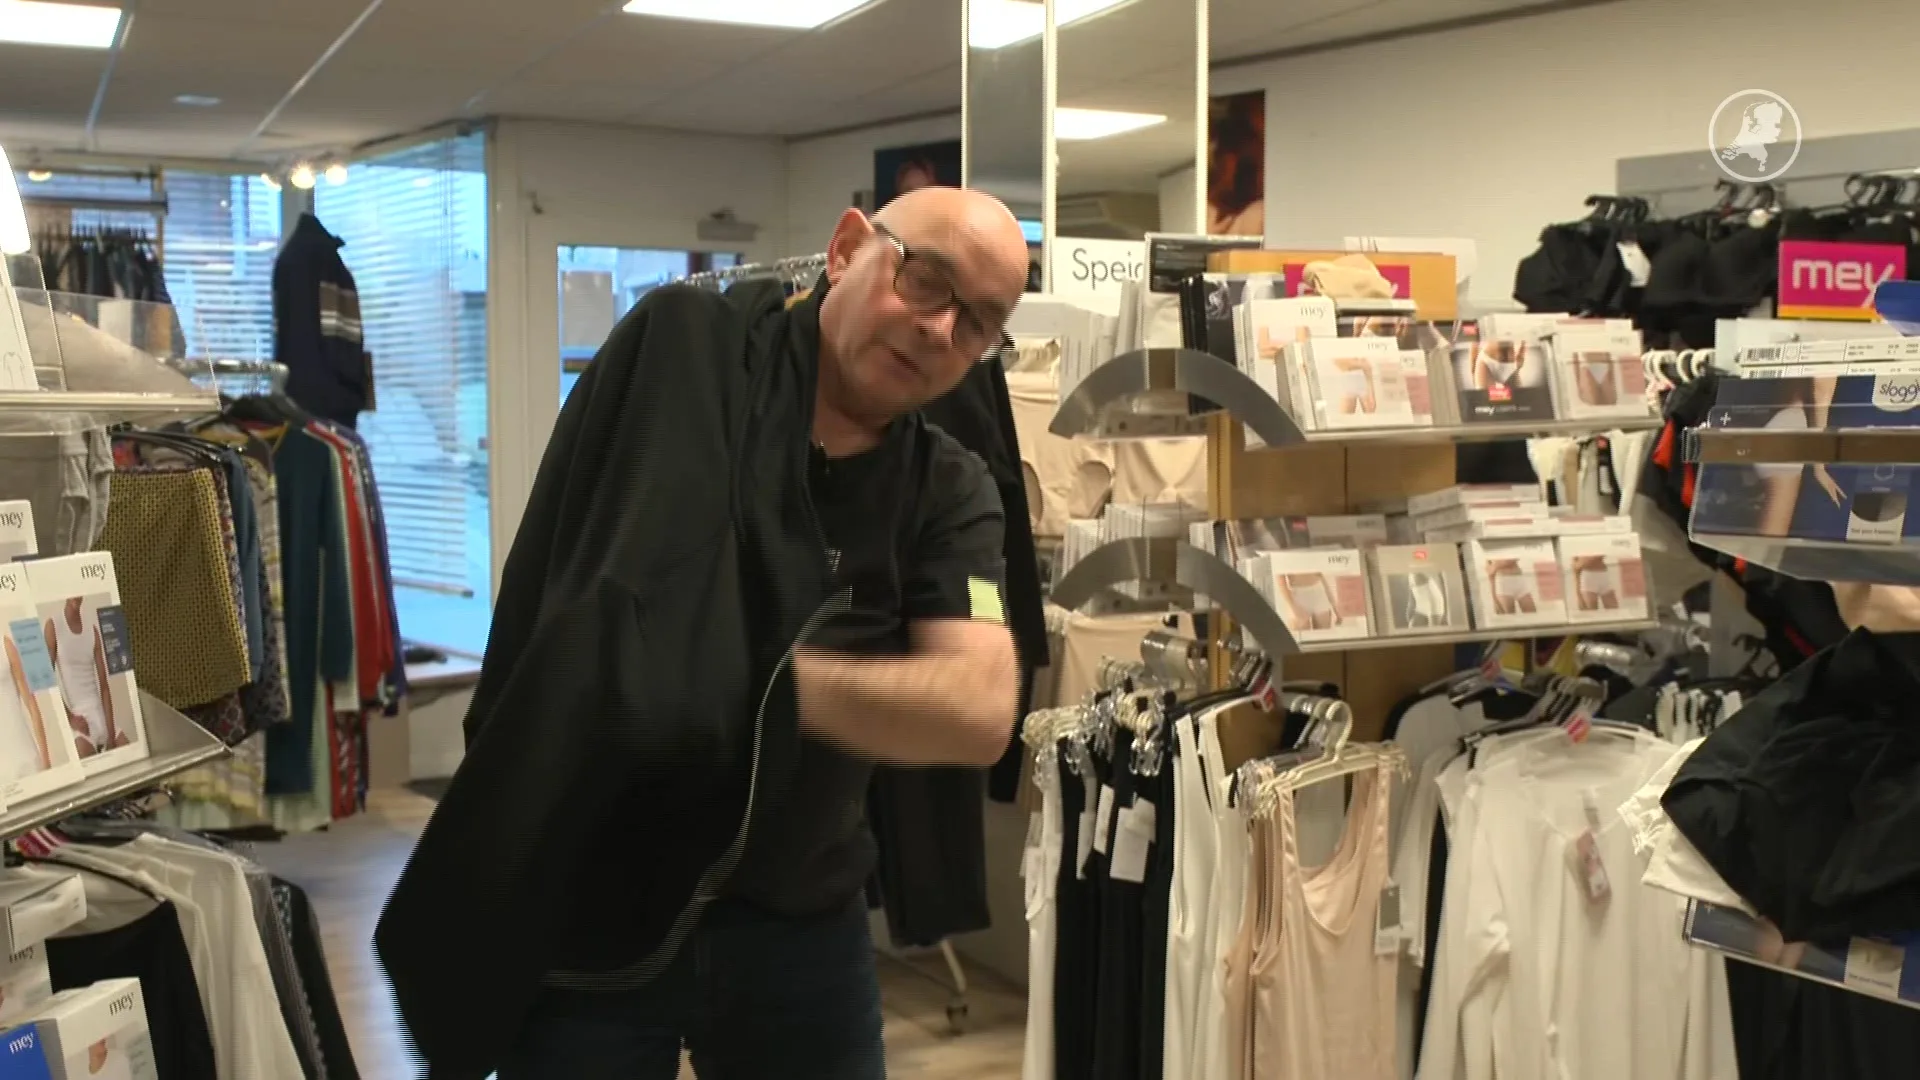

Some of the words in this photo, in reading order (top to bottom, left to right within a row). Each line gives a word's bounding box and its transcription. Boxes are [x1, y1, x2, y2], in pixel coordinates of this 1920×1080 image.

[1793, 259, 1895, 308] mey
[80, 563, 107, 581] mey
[109, 992, 135, 1016] mey
[9, 1032, 34, 1054] mey
